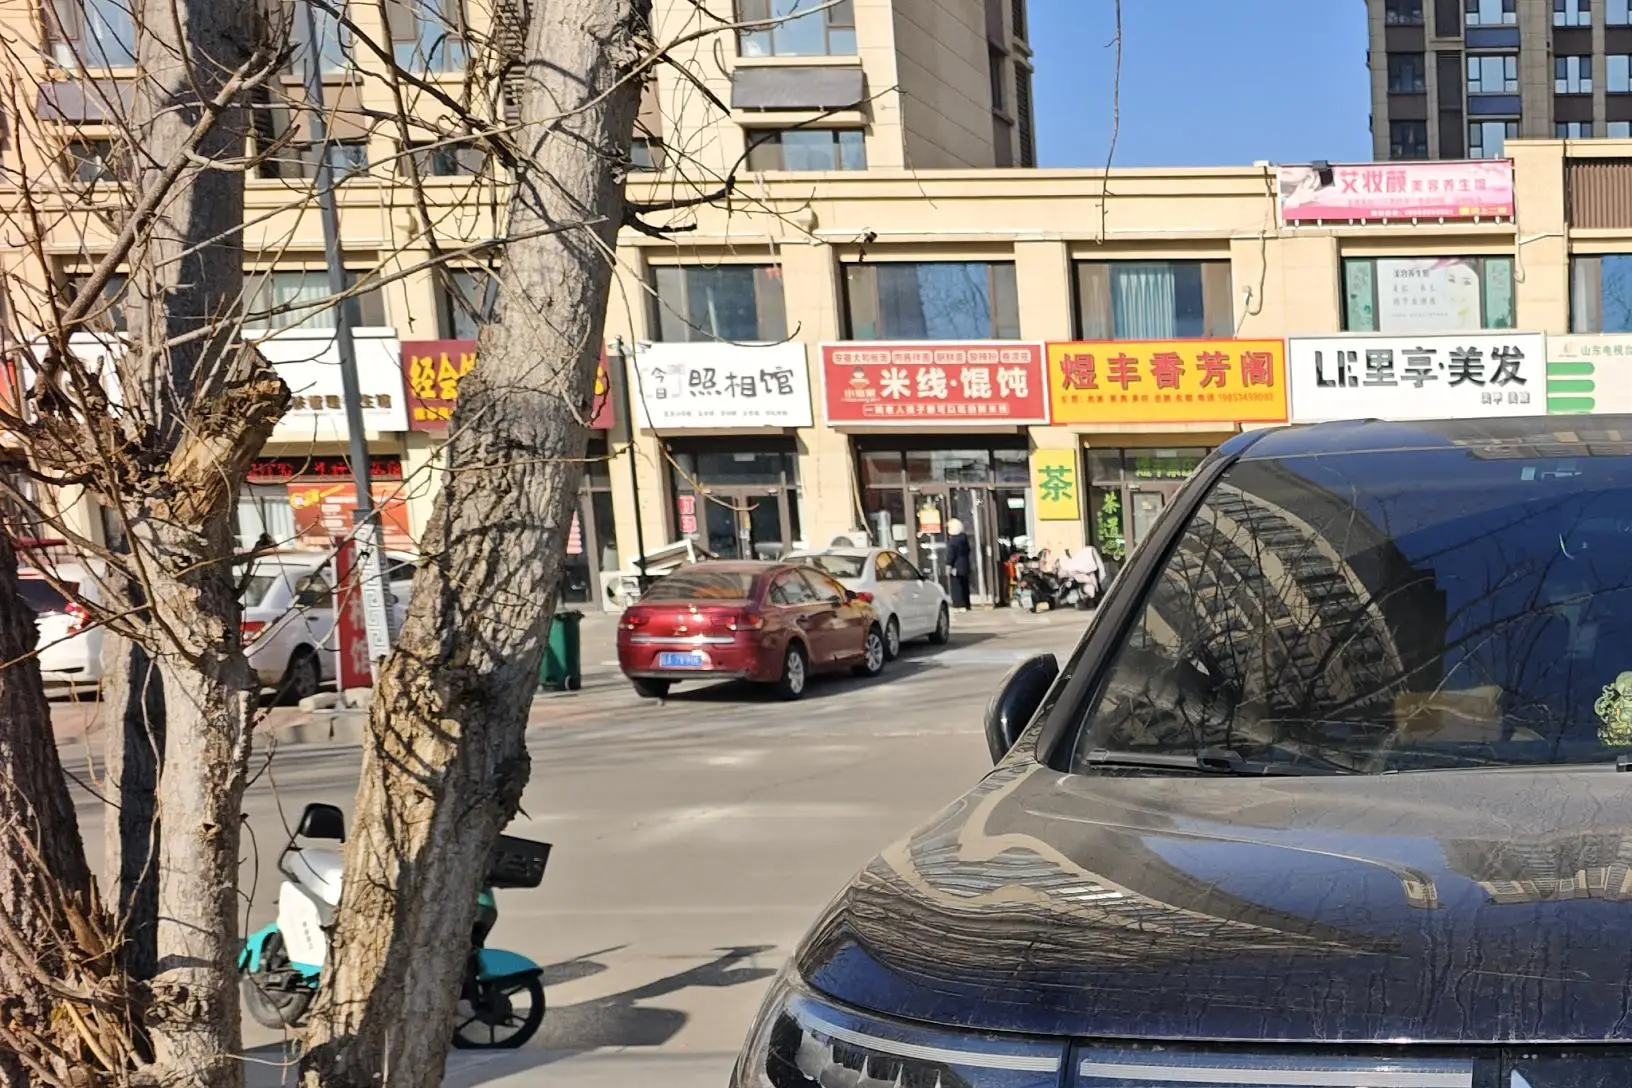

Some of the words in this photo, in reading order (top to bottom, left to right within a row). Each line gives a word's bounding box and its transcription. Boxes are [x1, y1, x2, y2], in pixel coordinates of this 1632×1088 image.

[688, 366, 794, 398] 照相馆
[1060, 351, 1275, 391] 煜丰香芳阁
[1037, 465, 1073, 502] 茶
